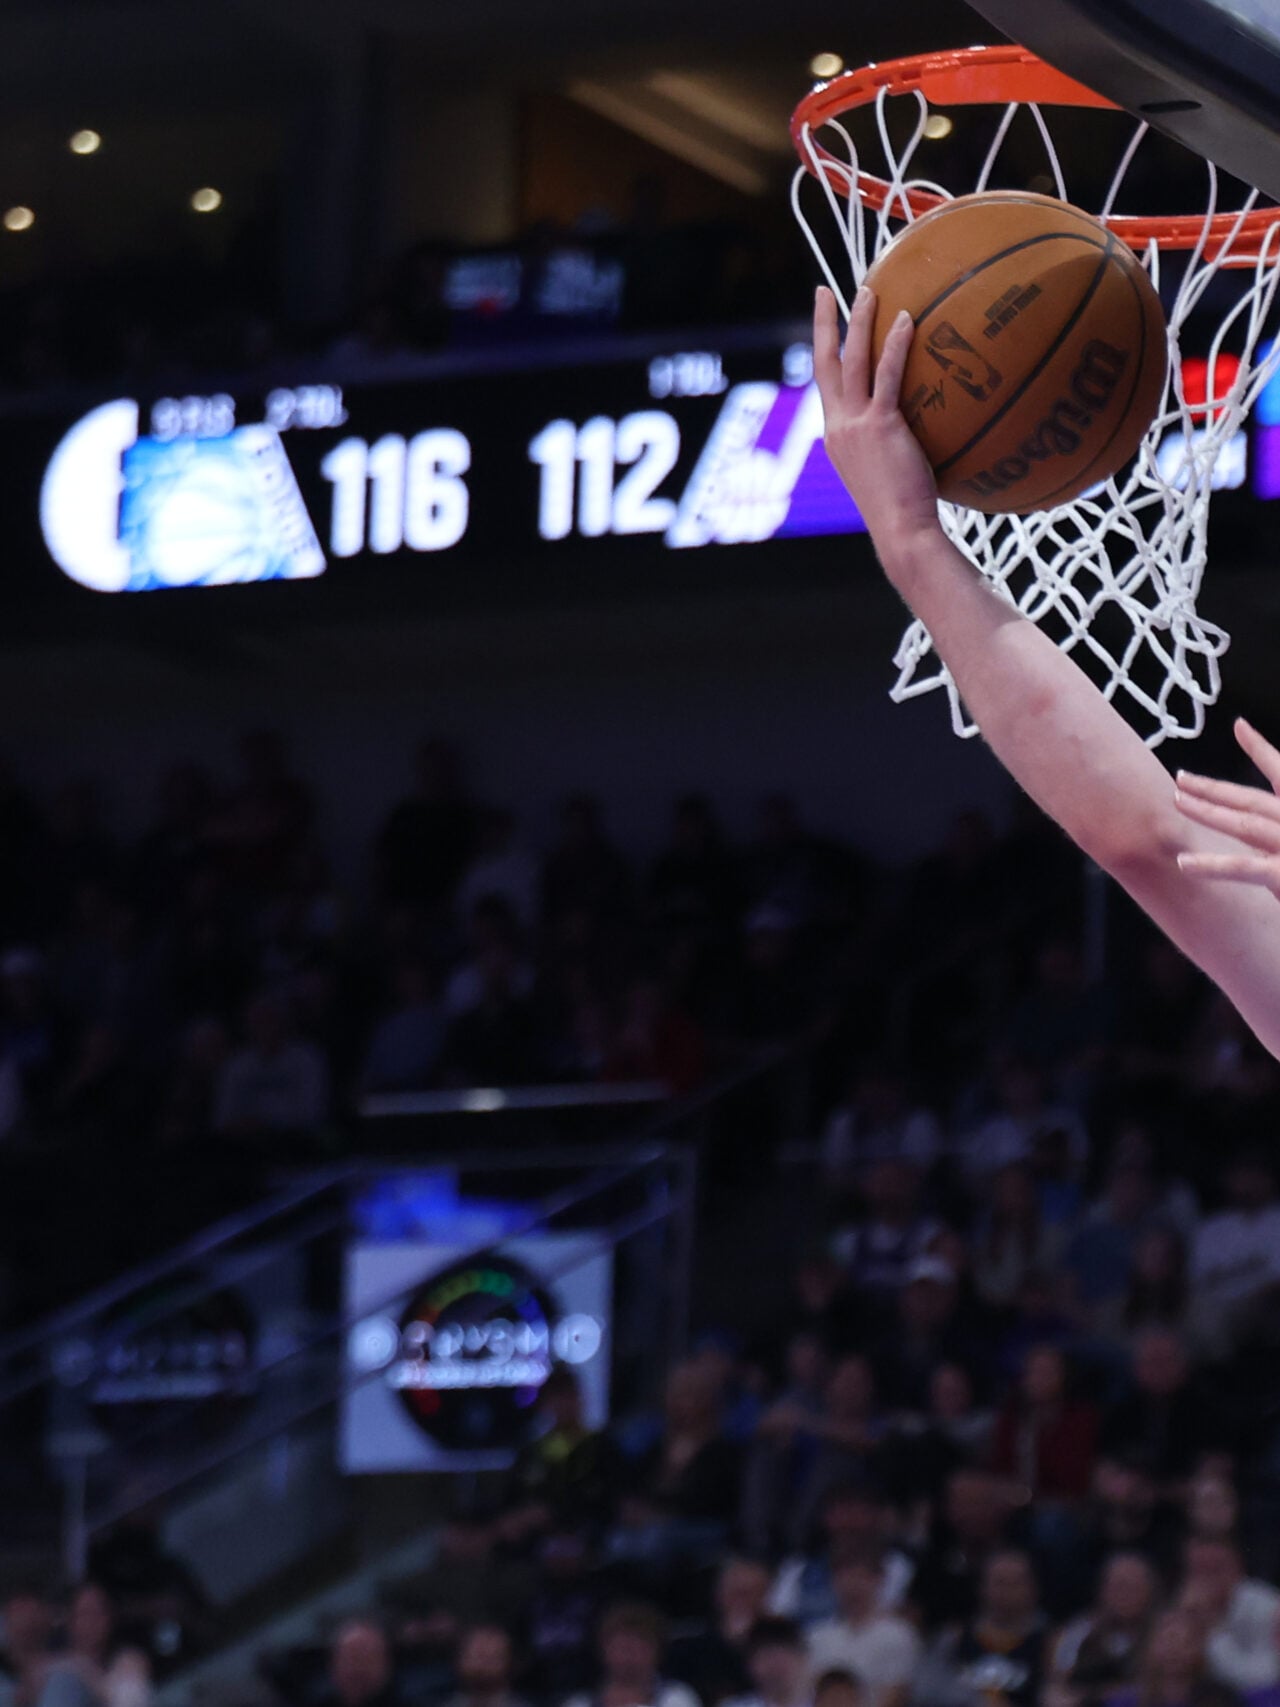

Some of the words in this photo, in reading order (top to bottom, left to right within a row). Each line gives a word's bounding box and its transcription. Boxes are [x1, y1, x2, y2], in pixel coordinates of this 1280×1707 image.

[529, 409, 681, 541] 112
[960, 339, 1131, 496] Wilson
[321, 428, 471, 558] 116
